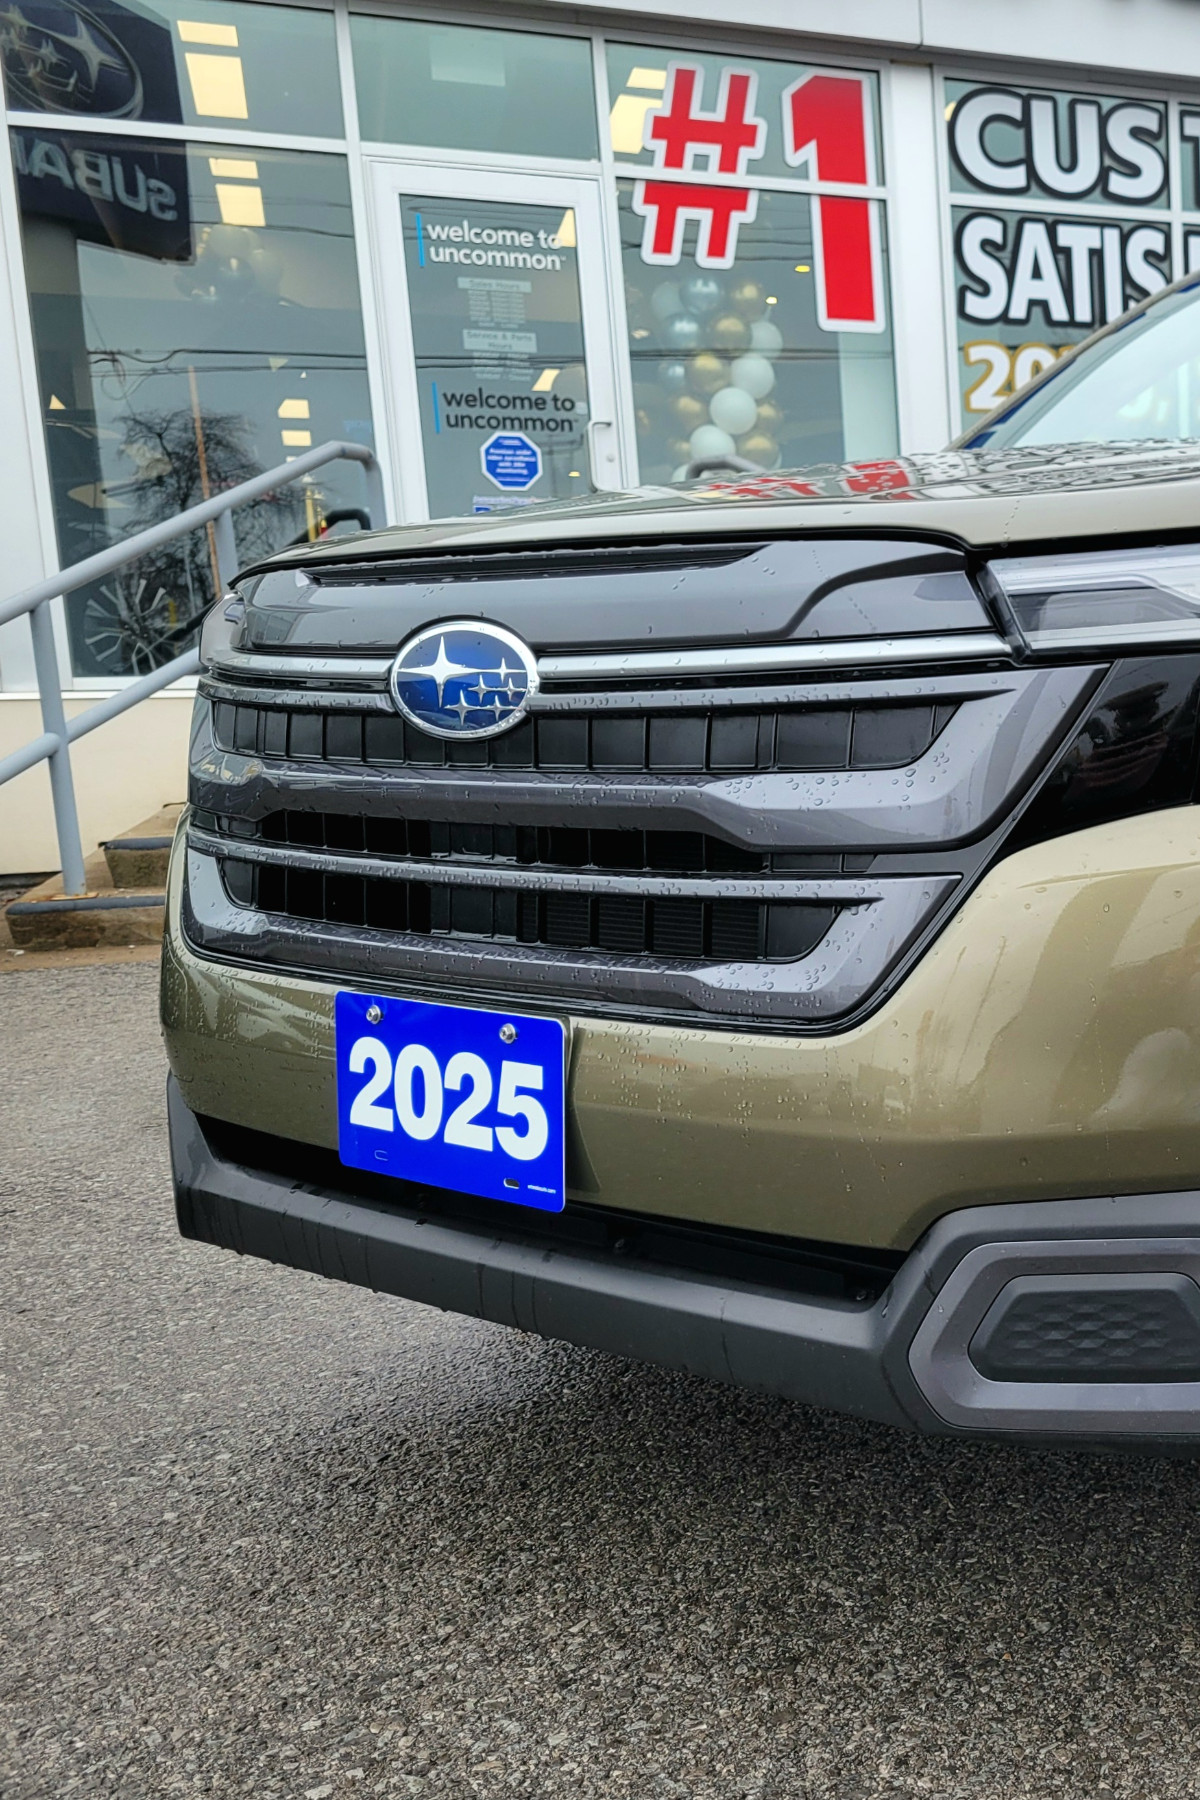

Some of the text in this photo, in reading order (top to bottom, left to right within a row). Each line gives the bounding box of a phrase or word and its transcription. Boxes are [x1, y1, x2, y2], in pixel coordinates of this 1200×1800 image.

[634, 61, 886, 333] #1
[426, 219, 562, 249] welcome to
[429, 246, 561, 271] uncommon
[442, 387, 575, 412] welcome to
[446, 414, 574, 432] uncommon
[349, 1036, 549, 1161] 2025
